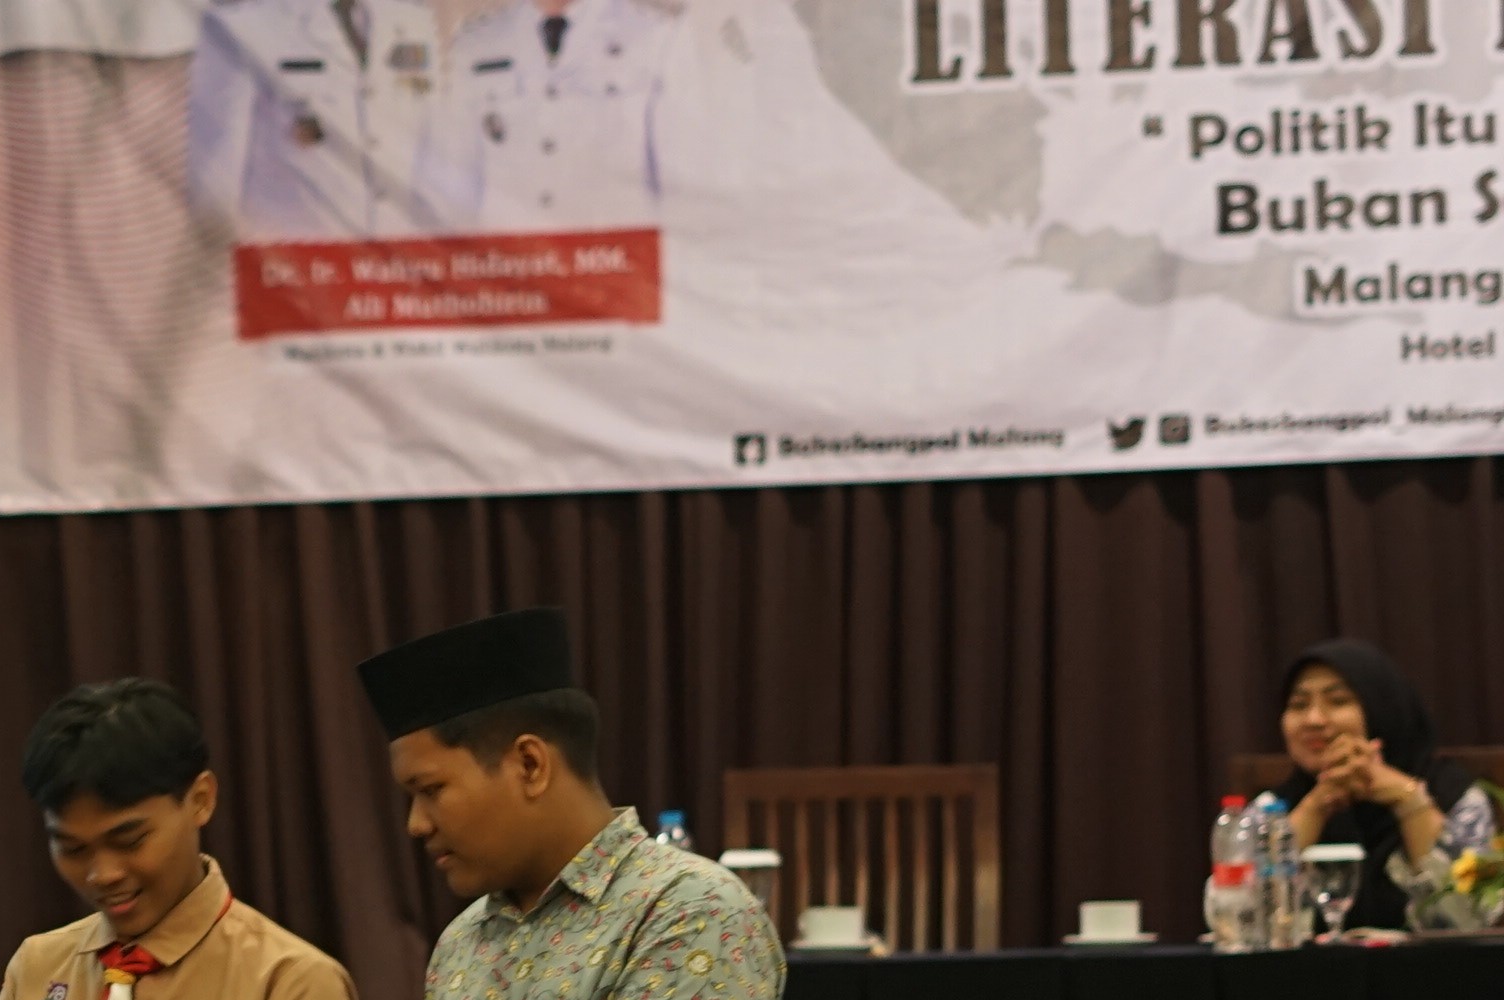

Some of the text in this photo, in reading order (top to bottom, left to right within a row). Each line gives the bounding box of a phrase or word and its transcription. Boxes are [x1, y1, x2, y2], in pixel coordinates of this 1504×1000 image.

[1189, 103, 1391, 160] Politik
[1413, 102, 1497, 148] Itu
[1216, 178, 1448, 236] Bukan
[1303, 262, 1502, 306] Malang
[1400, 330, 1496, 361] Hotel
